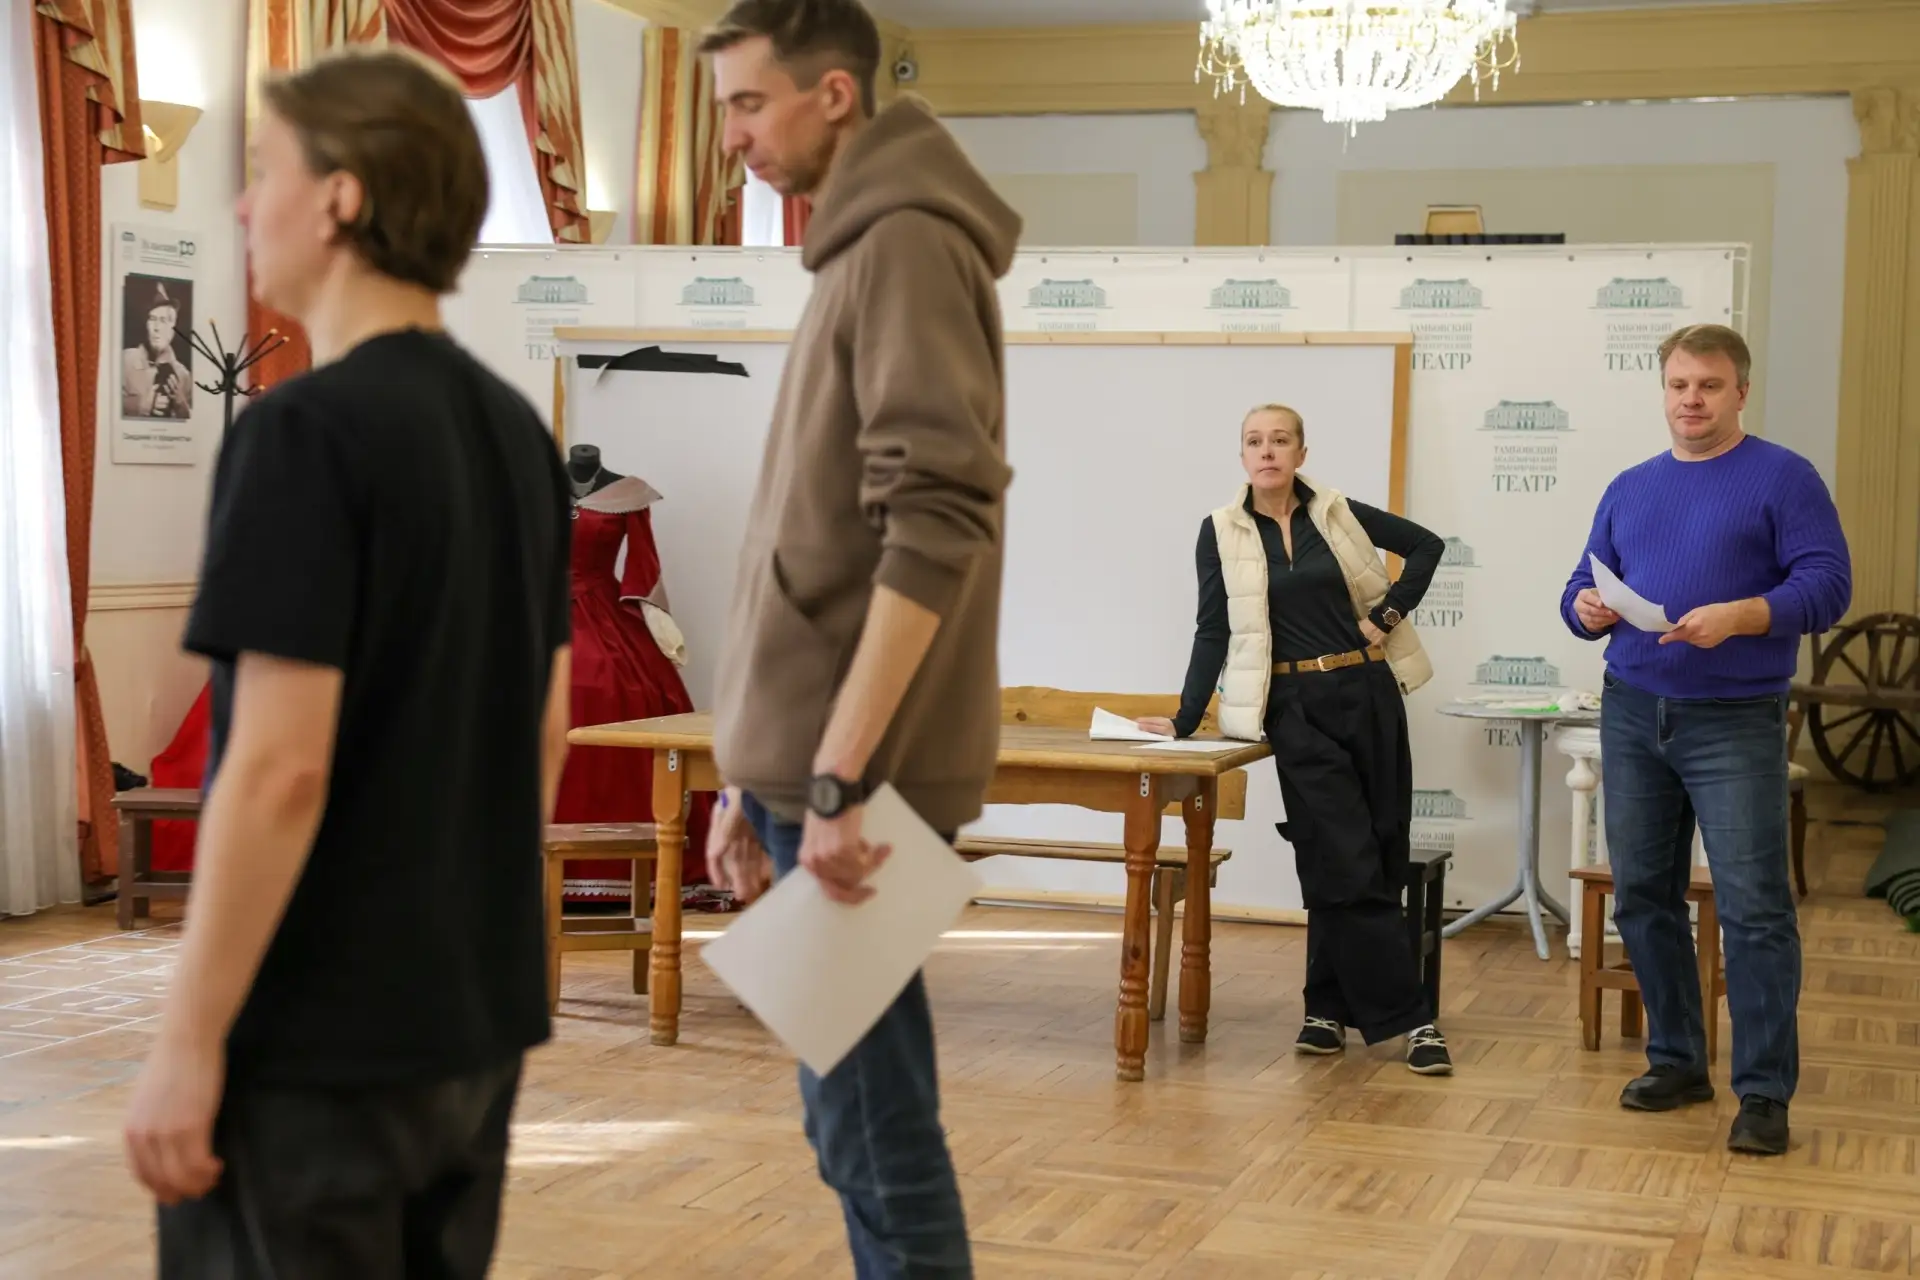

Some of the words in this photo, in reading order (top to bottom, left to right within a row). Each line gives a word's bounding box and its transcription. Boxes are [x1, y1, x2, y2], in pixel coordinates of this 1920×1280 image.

[1604, 353, 1658, 371] ТЕАТ
[1492, 474, 1558, 492] ТЕАТР
[1414, 609, 1464, 627] ЕАТР
